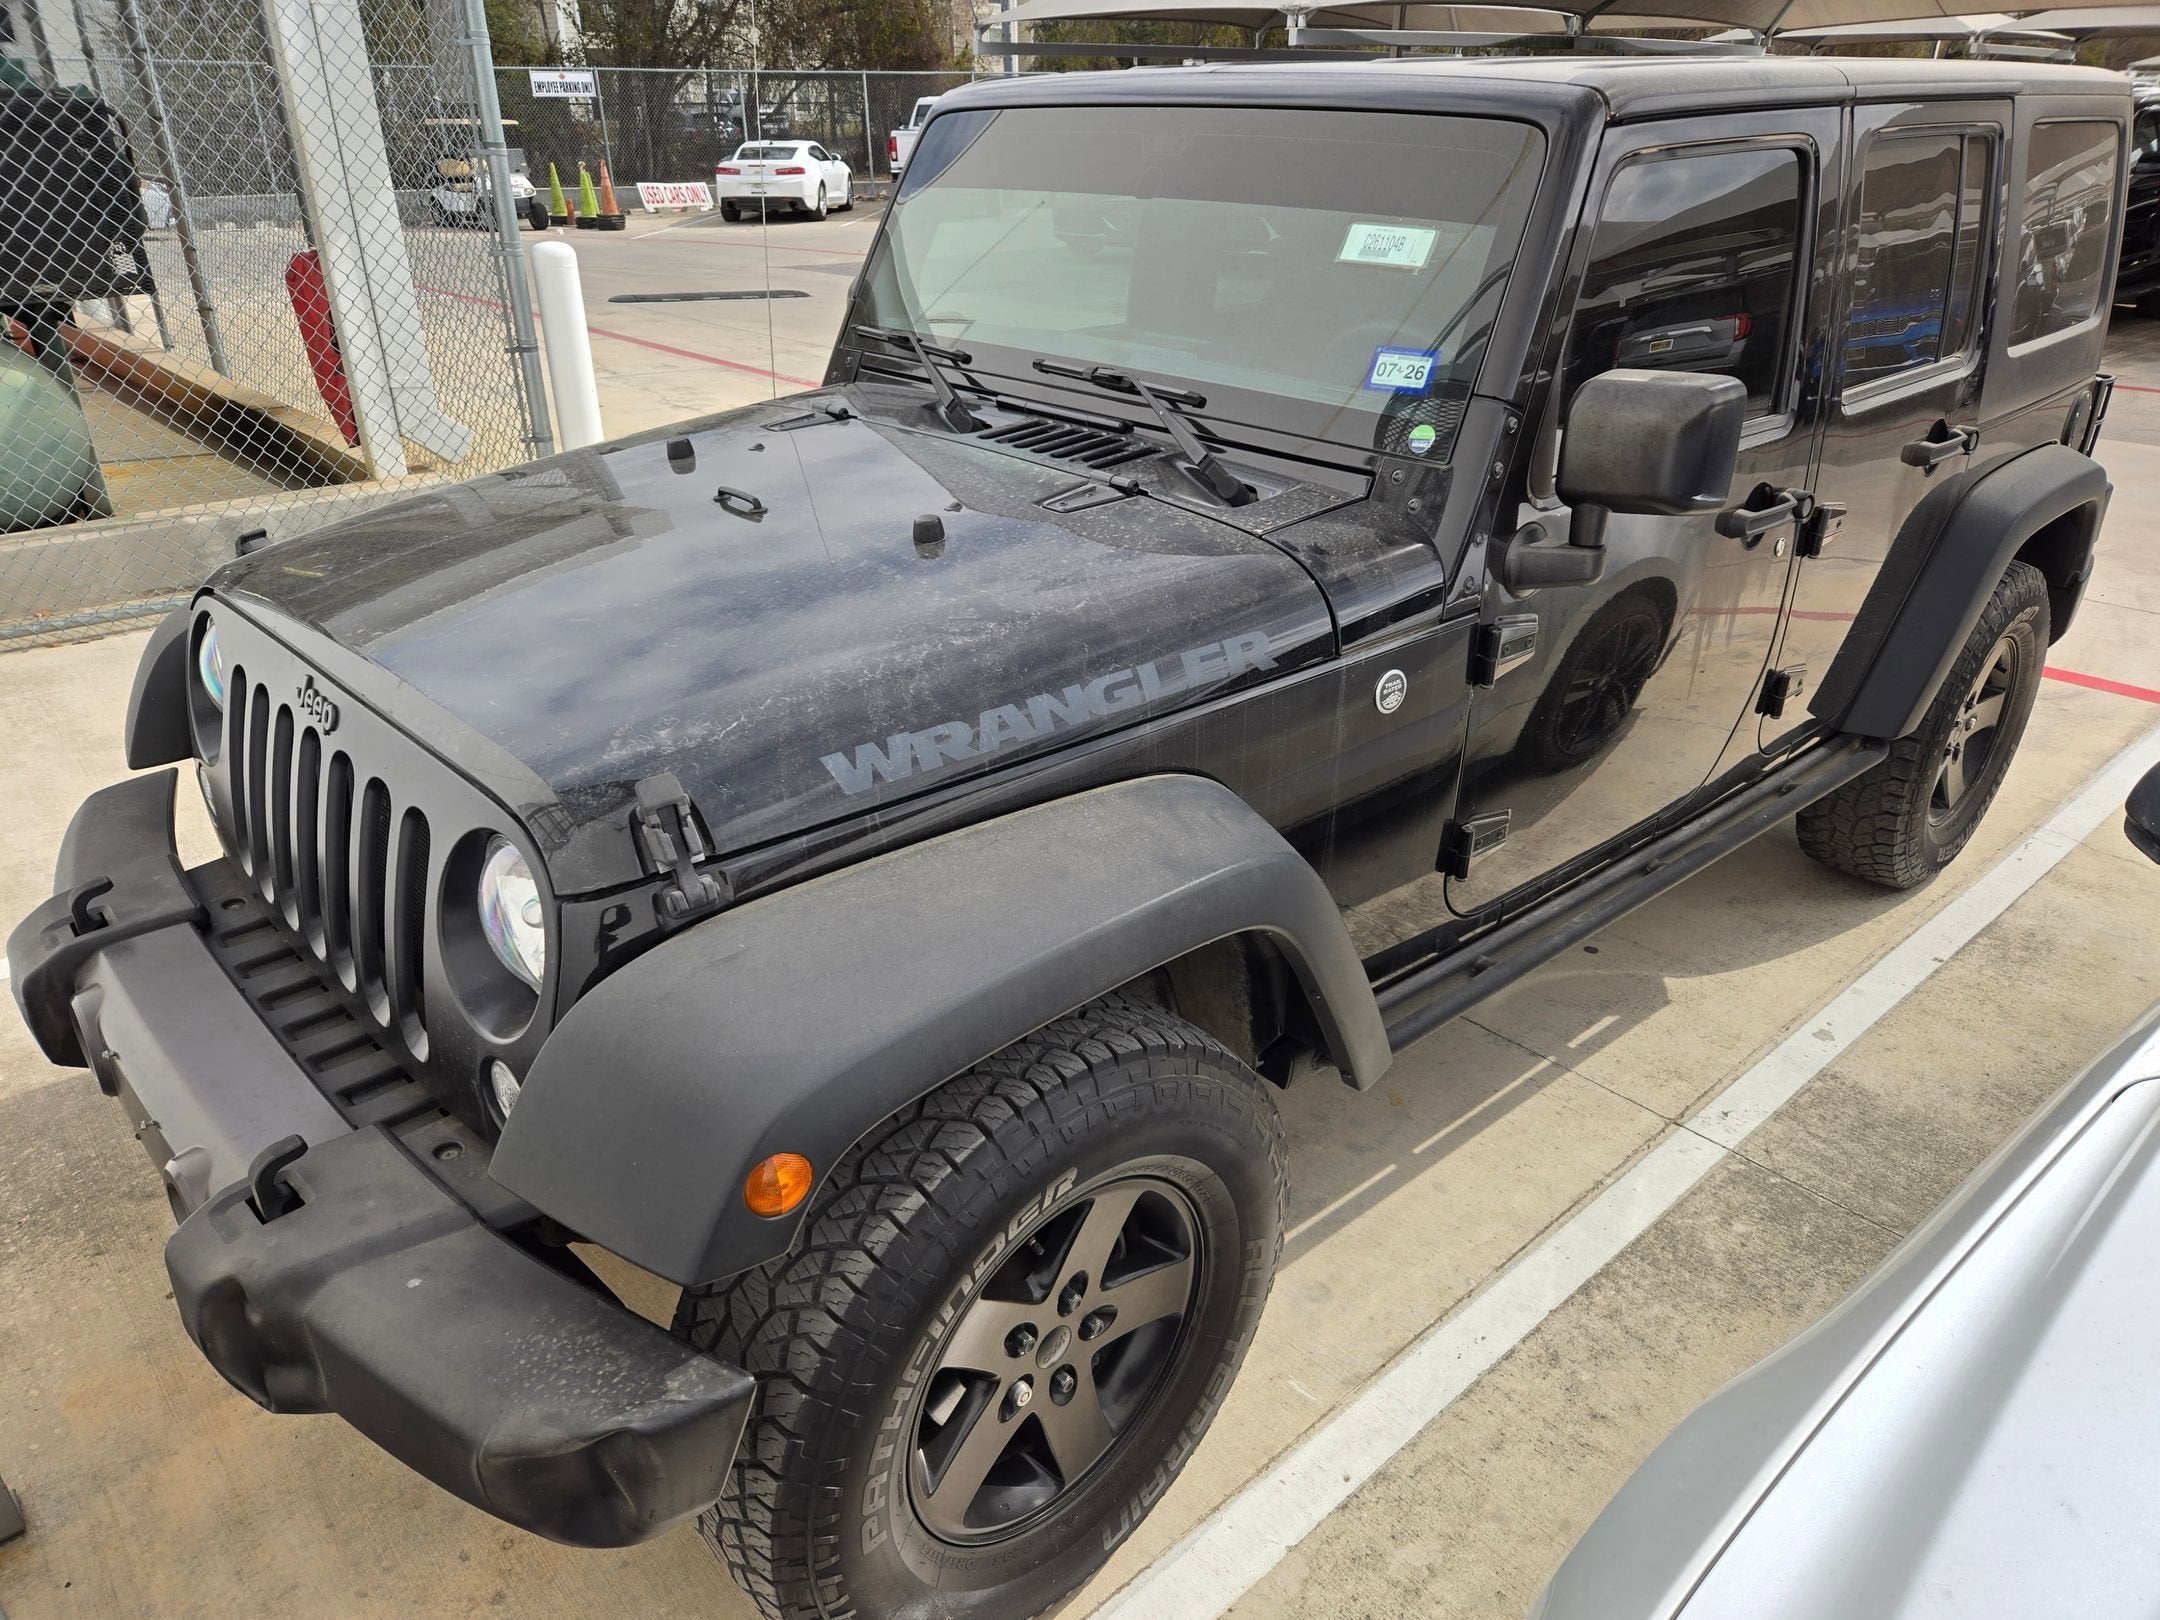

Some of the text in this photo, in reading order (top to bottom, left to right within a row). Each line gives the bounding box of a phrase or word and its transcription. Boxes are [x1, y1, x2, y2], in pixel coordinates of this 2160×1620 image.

[534, 81, 593, 93] EMPLOYEE PARKING ONLY
[640, 185, 709, 204] USED CARS ONLY
[1376, 362, 1426, 380] 07 26
[296, 674, 339, 736] Jeep
[819, 630, 1279, 795] WRANGLER
[861, 1167, 1077, 1560] PATHFINDER
[1102, 1330, 1248, 1550] TERRAIN
